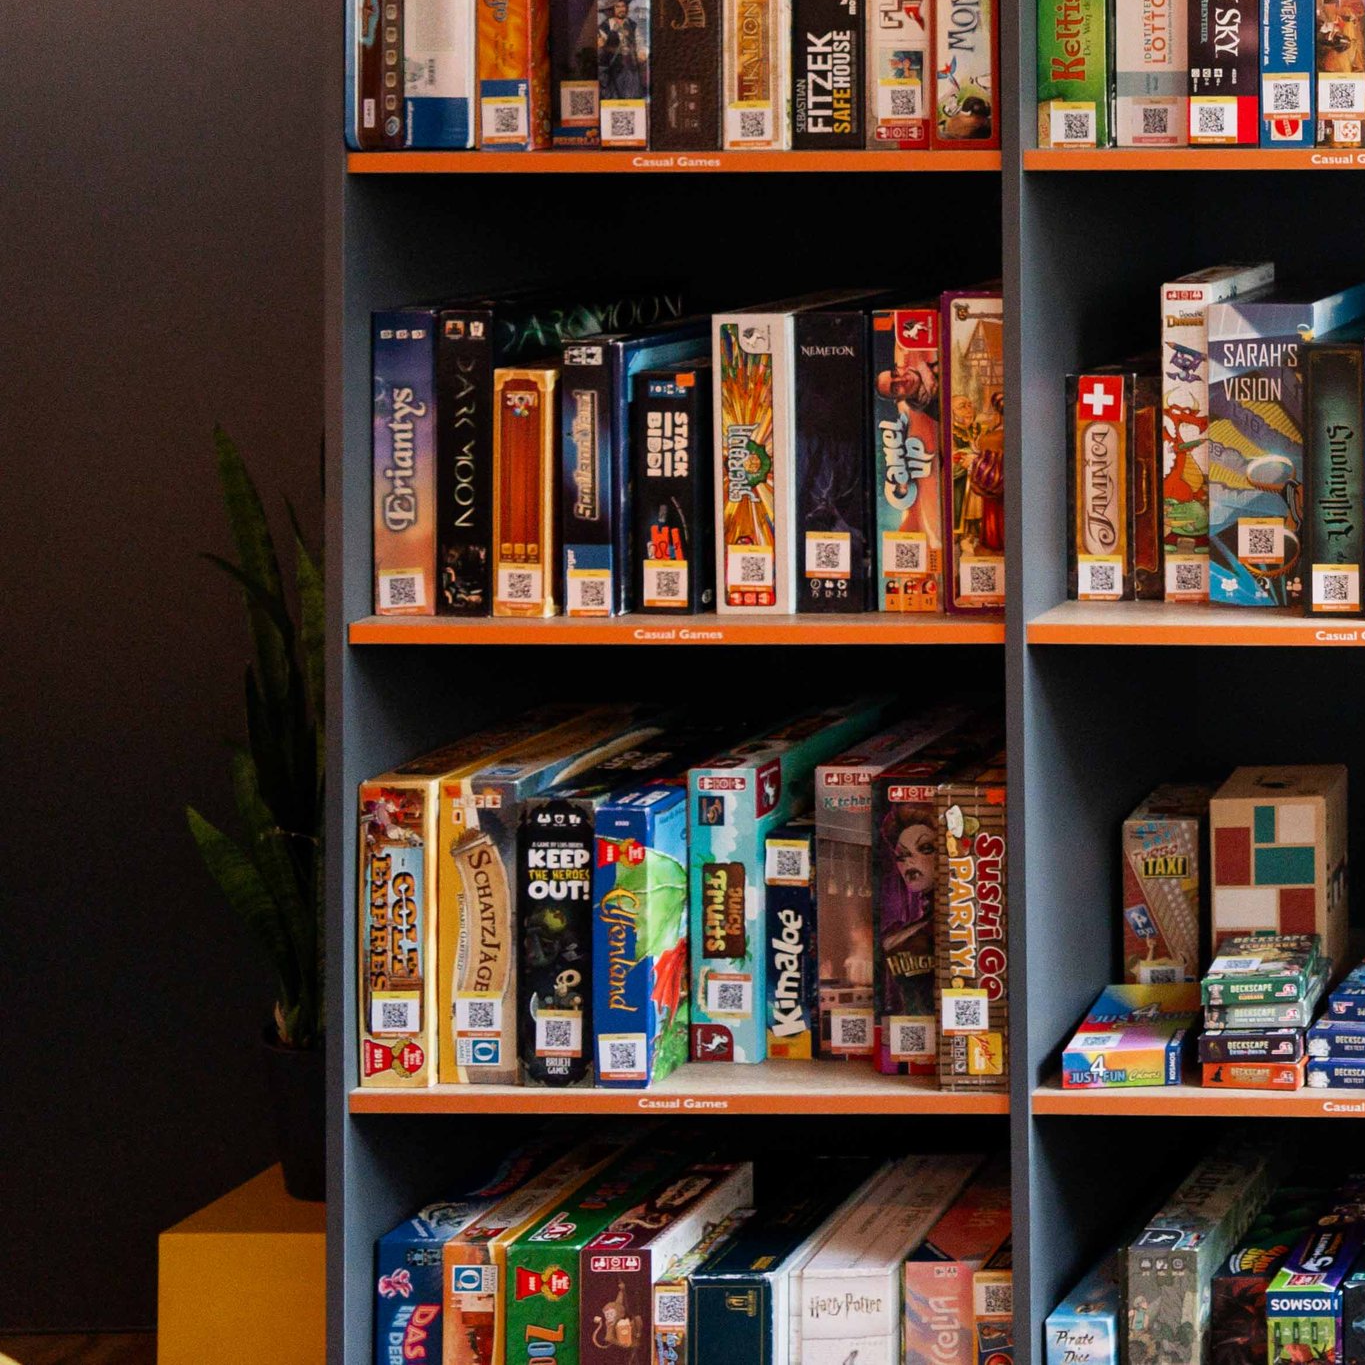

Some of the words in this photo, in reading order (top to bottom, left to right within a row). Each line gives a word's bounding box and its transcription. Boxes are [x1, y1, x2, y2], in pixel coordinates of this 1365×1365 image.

[1215, 9, 1241, 57] SKY
[807, 33, 833, 132] FITZEK
[833, 30, 851, 133] SAFEHOUSE
[632, 156, 674, 167] Casual
[679, 156, 720, 167] Games
[1311, 154, 1354, 164] Casual
[801, 345, 854, 358] NEMETON
[1224, 344, 1298, 366] SARAH'S
[1224, 378, 1281, 400] VISION
[674, 412, 687, 476] STACK
[634, 629, 676, 640] Casual
[681, 629, 722, 640] Games
[1315, 631, 1358, 641] Casual
[528, 850, 589, 867] KEEP
[1145, 859, 1185, 877] TAXI
[528, 882, 590, 899] OUT!
[950, 859, 976, 978] PARTY!
[773, 910, 806, 1037] Kimaloé
[1230, 984, 1273, 995] DECKSCAPE
[1227, 1041, 1268, 1052] DECKSCAPE
[638, 1099, 681, 1109] Casual
[685, 1099, 727, 1109] Games
[1322, 1102, 1365, 1113] Casual
[1270, 1297, 1332, 1312] KOSMOS
